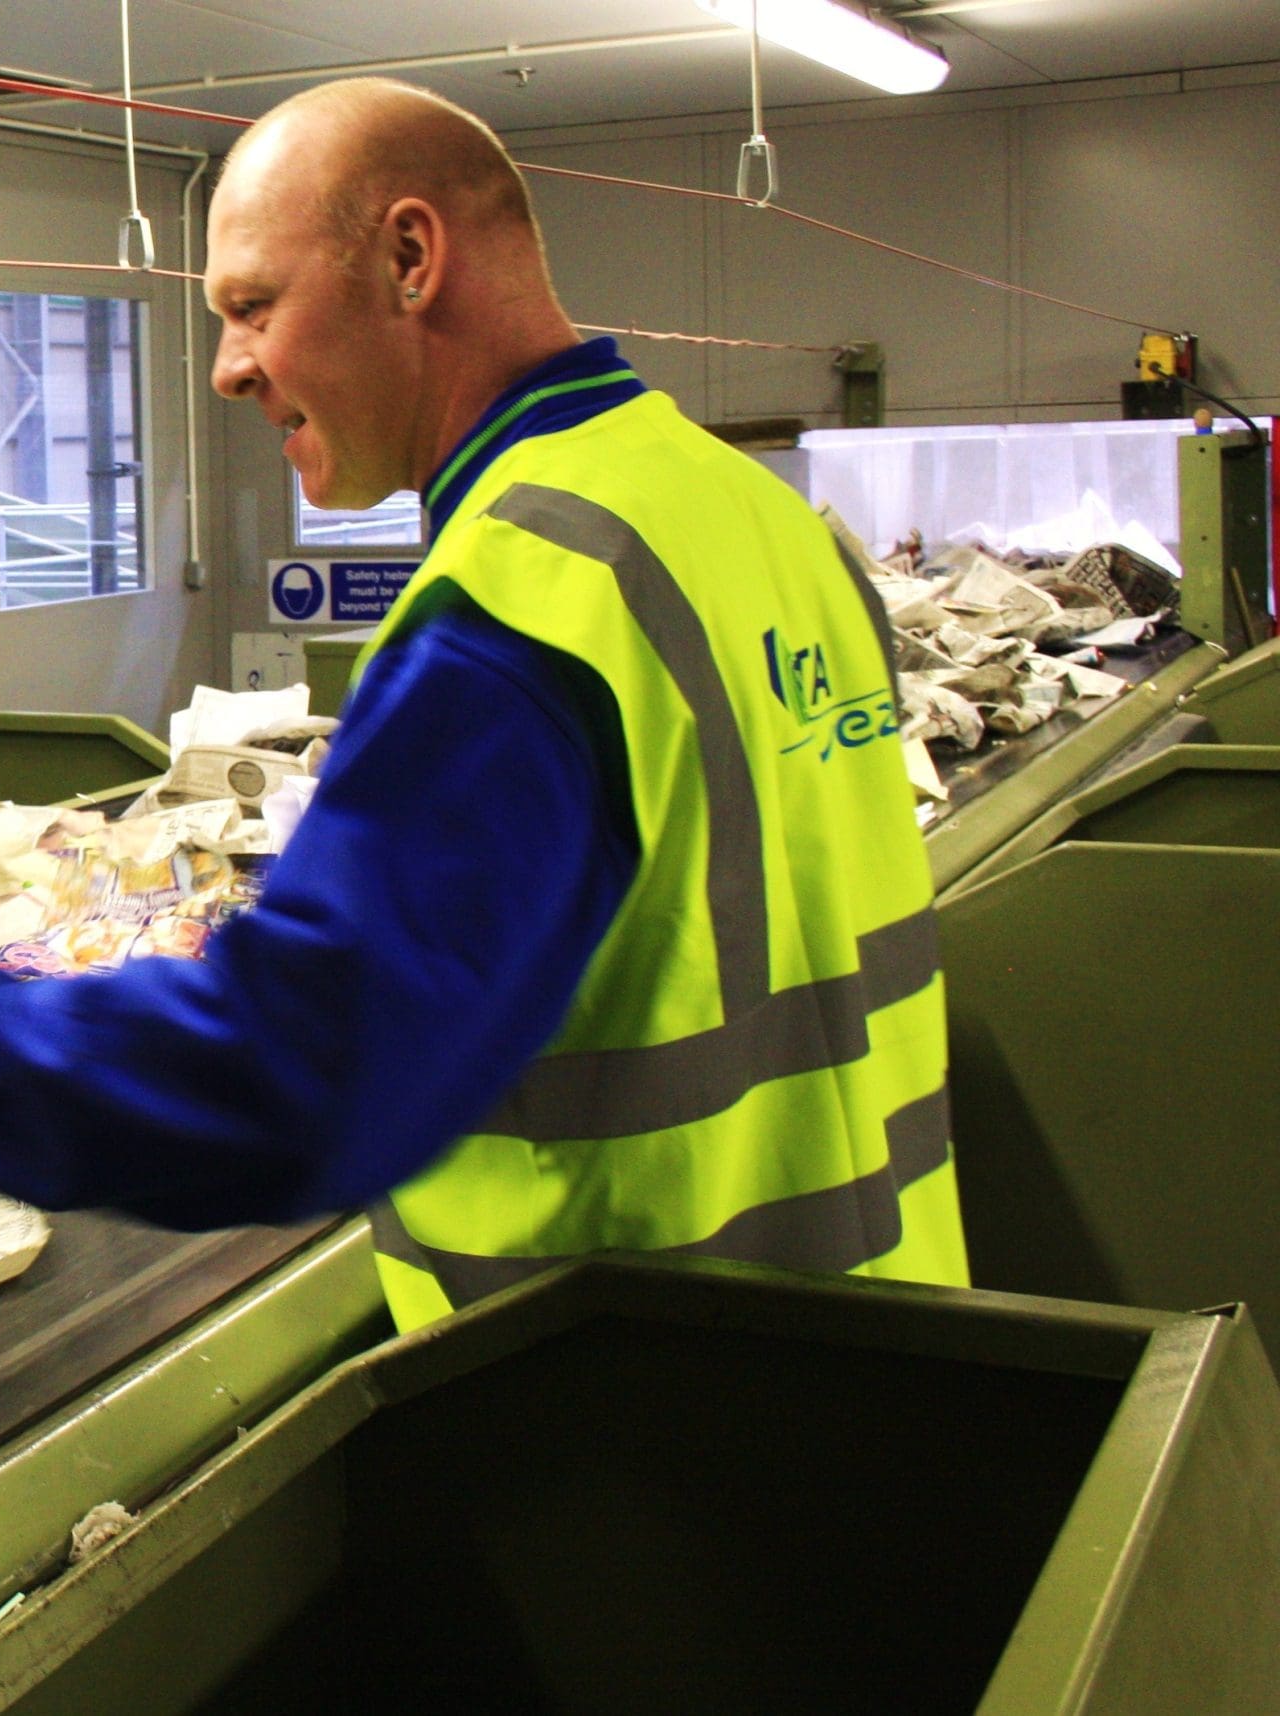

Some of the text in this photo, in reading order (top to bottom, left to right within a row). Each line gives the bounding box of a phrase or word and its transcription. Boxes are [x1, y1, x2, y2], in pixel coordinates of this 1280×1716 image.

[346, 569, 413, 583] Safety helm
[350, 586, 377, 596] must
[380, 586, 394, 596] be
[339, 601, 381, 615] beyond
